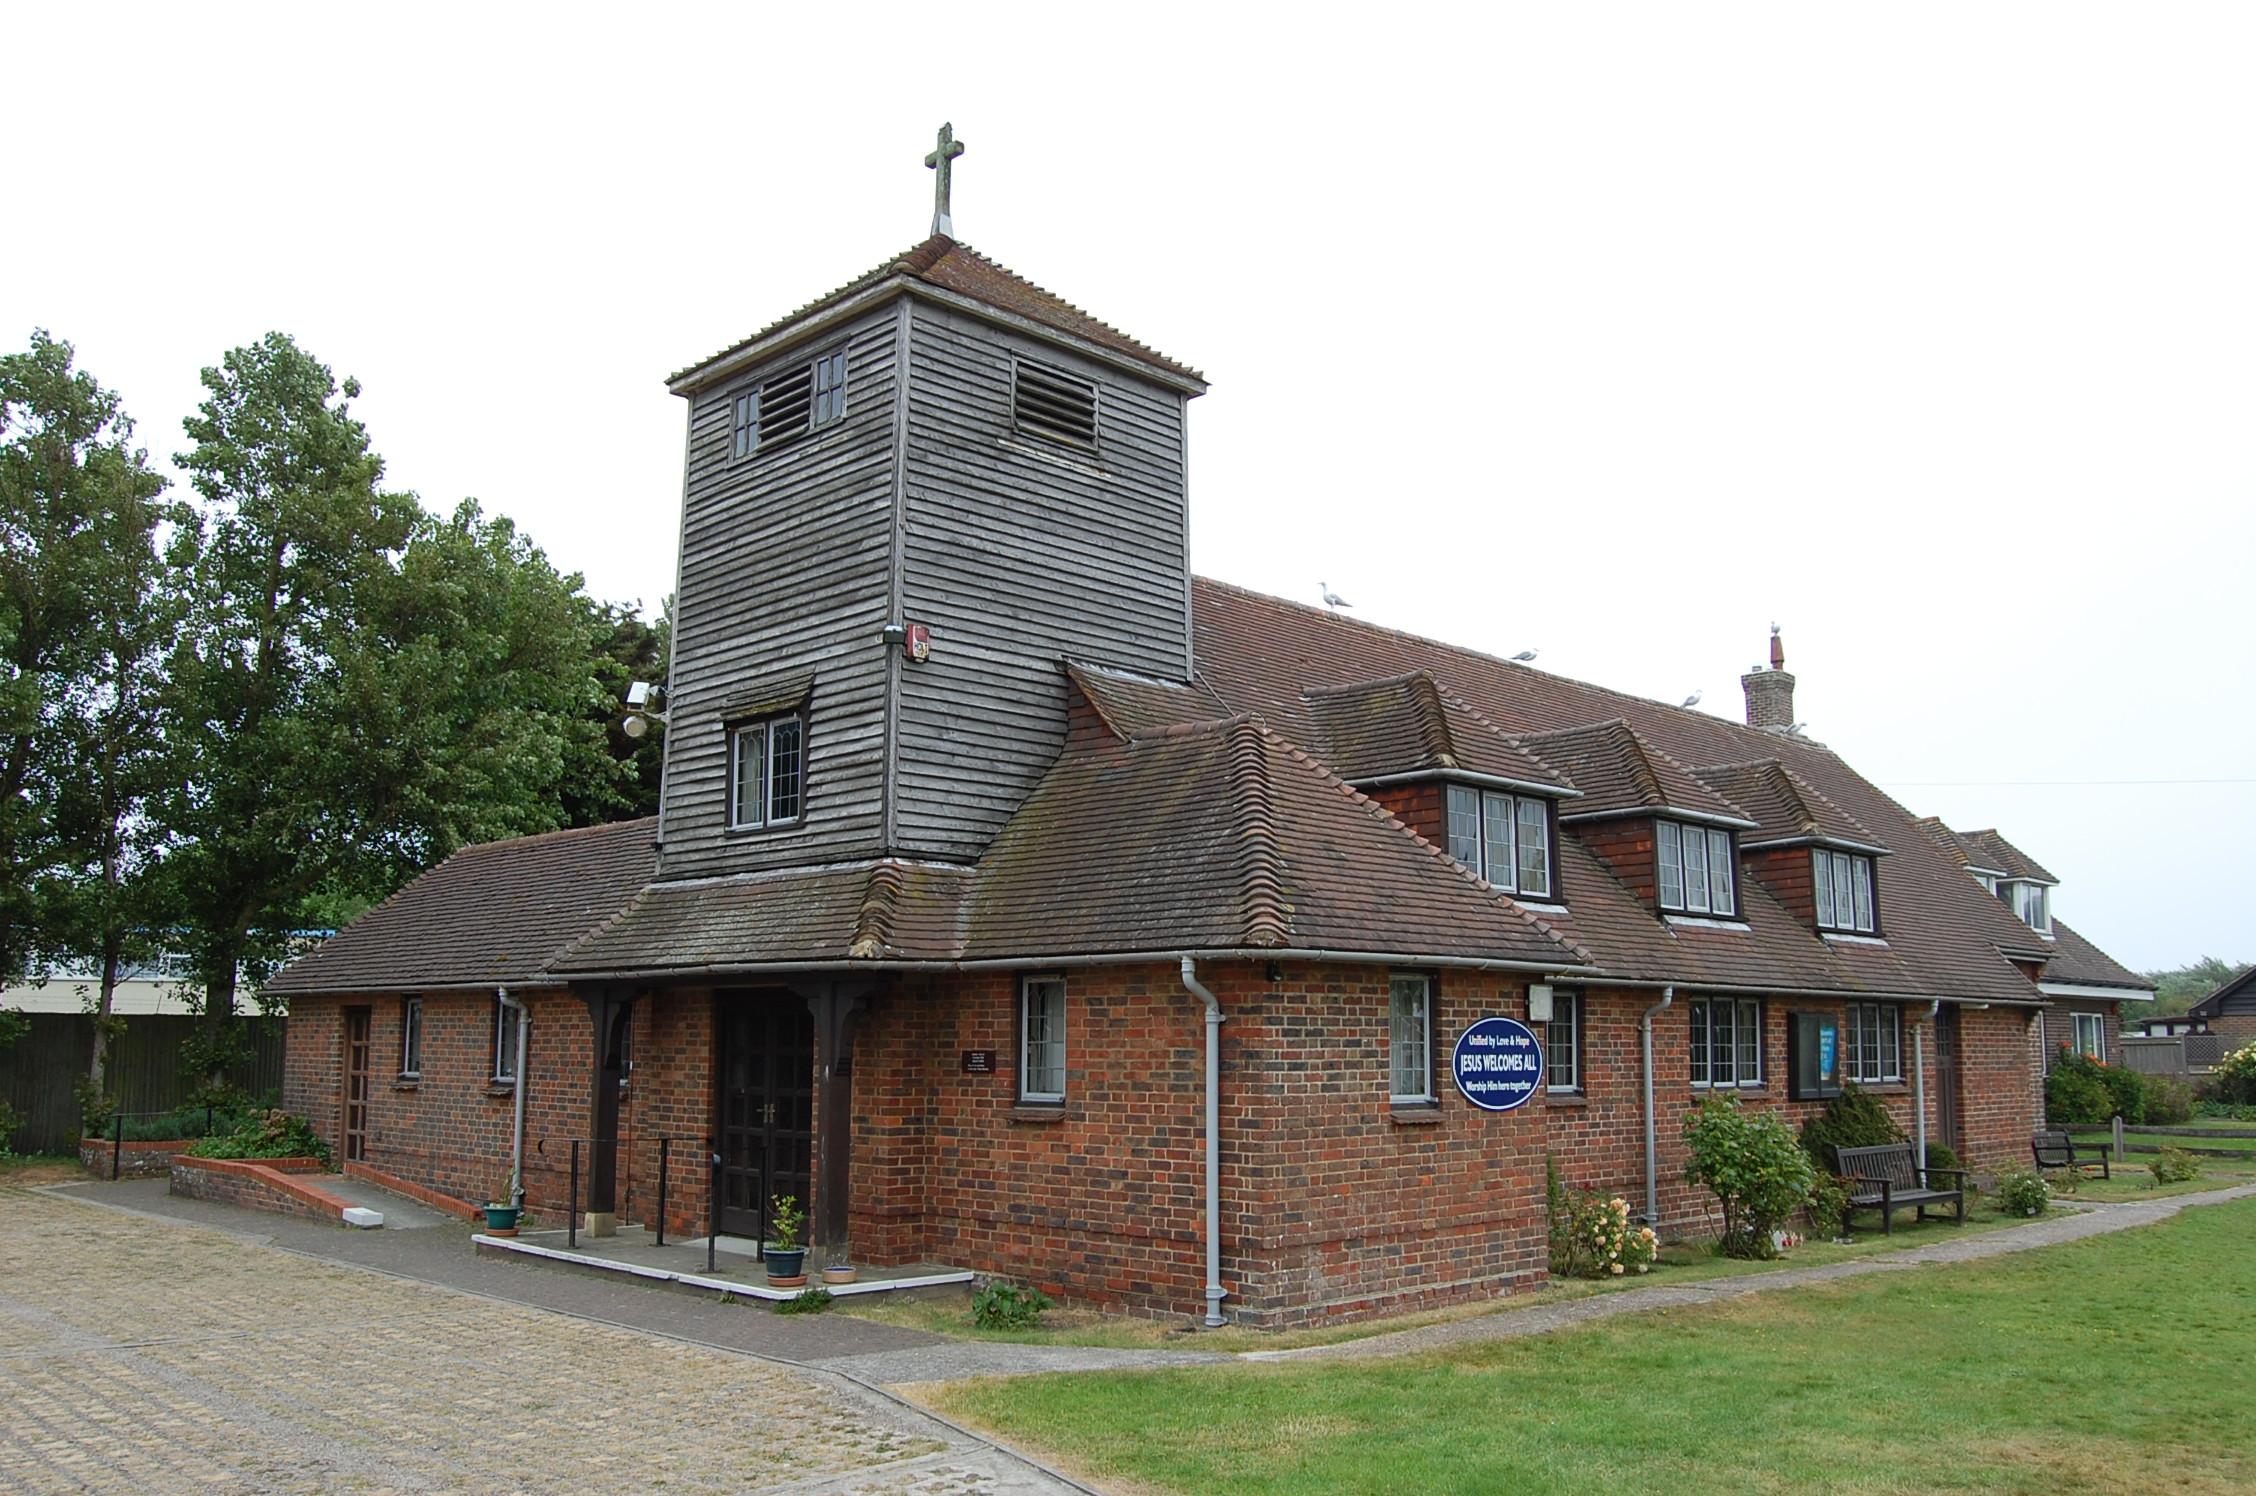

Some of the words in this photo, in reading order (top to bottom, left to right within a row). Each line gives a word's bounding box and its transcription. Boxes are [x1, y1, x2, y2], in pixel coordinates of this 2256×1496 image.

[1489, 1035, 1495, 1049] by
[1496, 1035, 1509, 1046] Love
[1510, 1036, 1514, 1046] &
[1516, 1036, 1529, 1048] Hope
[1460, 1055, 1482, 1076] JESUS
[1483, 1054, 1522, 1072] WELCOMES
[1524, 1054, 1537, 1071] ALL
[1465, 1080, 1487, 1094] Worship
[1487, 1080, 1498, 1091] Him
[1498, 1080, 1510, 1091] here
[1510, 1080, 1531, 1093] together
